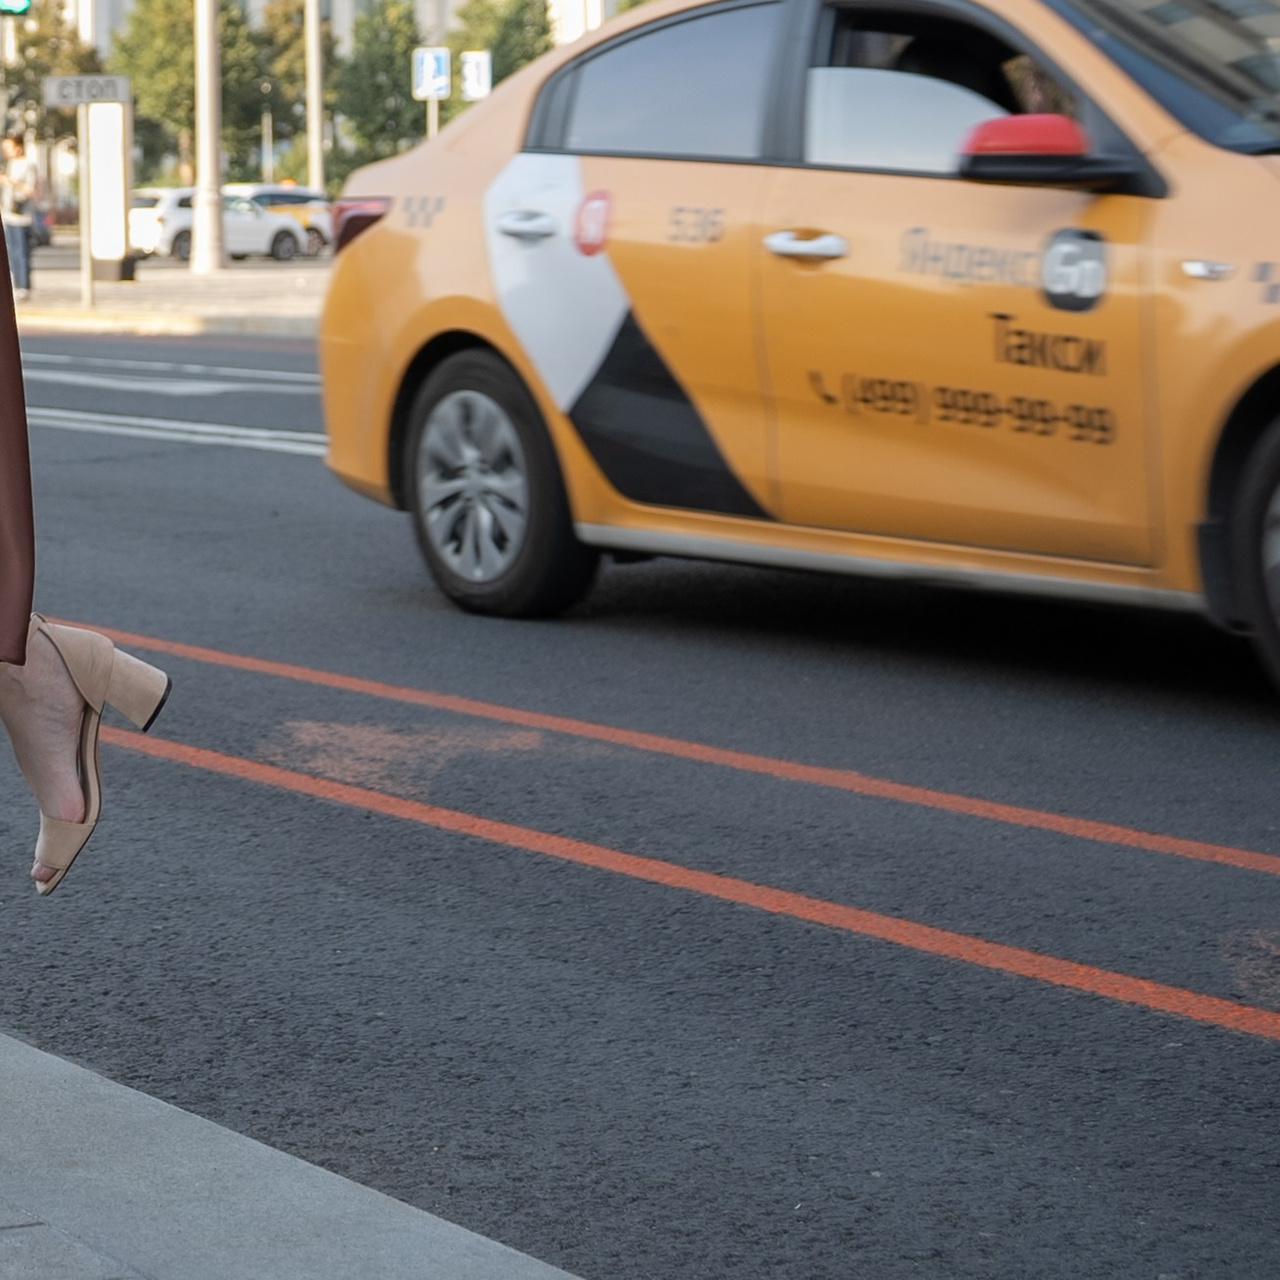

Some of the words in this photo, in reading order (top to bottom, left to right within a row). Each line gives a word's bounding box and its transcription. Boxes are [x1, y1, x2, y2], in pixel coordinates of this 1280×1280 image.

[58, 78, 118, 100] СТОП
[988, 312, 1108, 376] Такси
[842, 372, 931, 425] (499)
[933, 385, 1119, 445] 999-99-99
